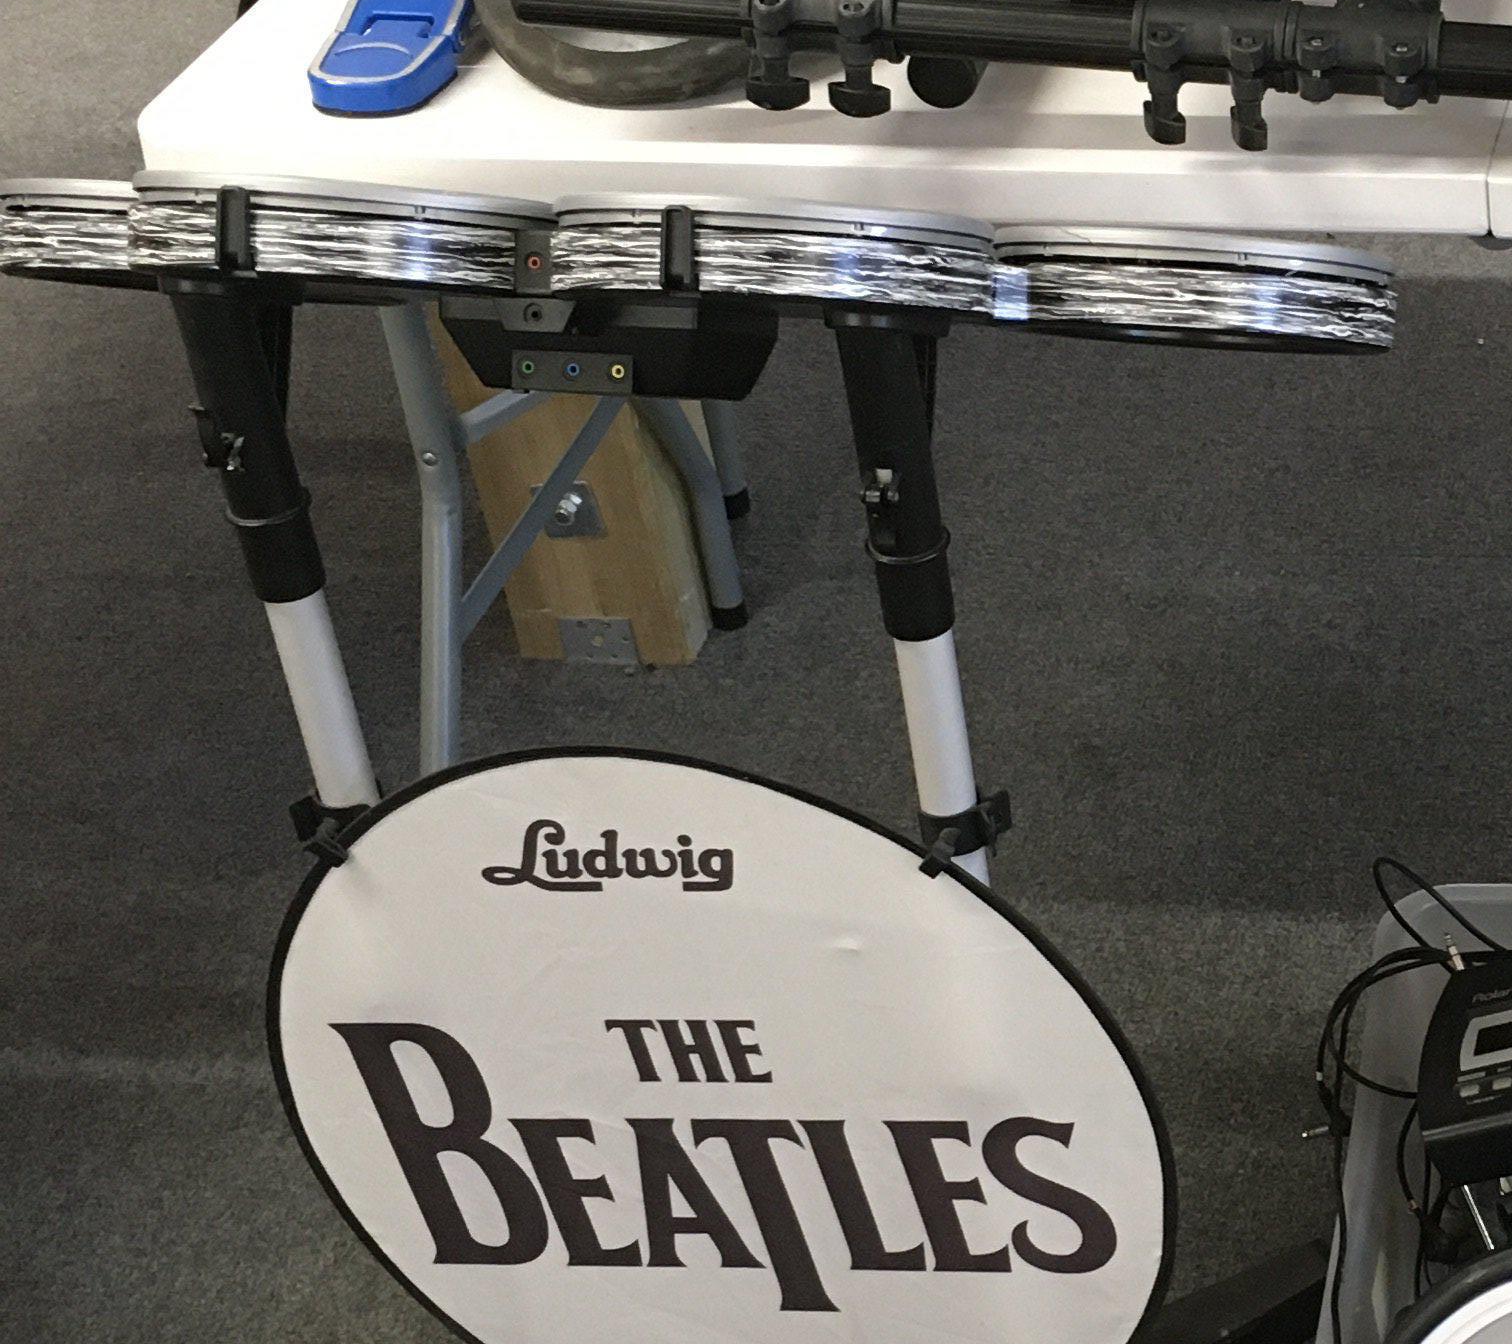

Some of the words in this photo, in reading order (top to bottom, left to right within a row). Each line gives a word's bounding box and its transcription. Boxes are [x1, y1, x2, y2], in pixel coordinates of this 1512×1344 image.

[481, 818, 735, 893] Ludwig
[604, 1018, 775, 1084] THE
[327, 1022, 1120, 1314] BEATLES
